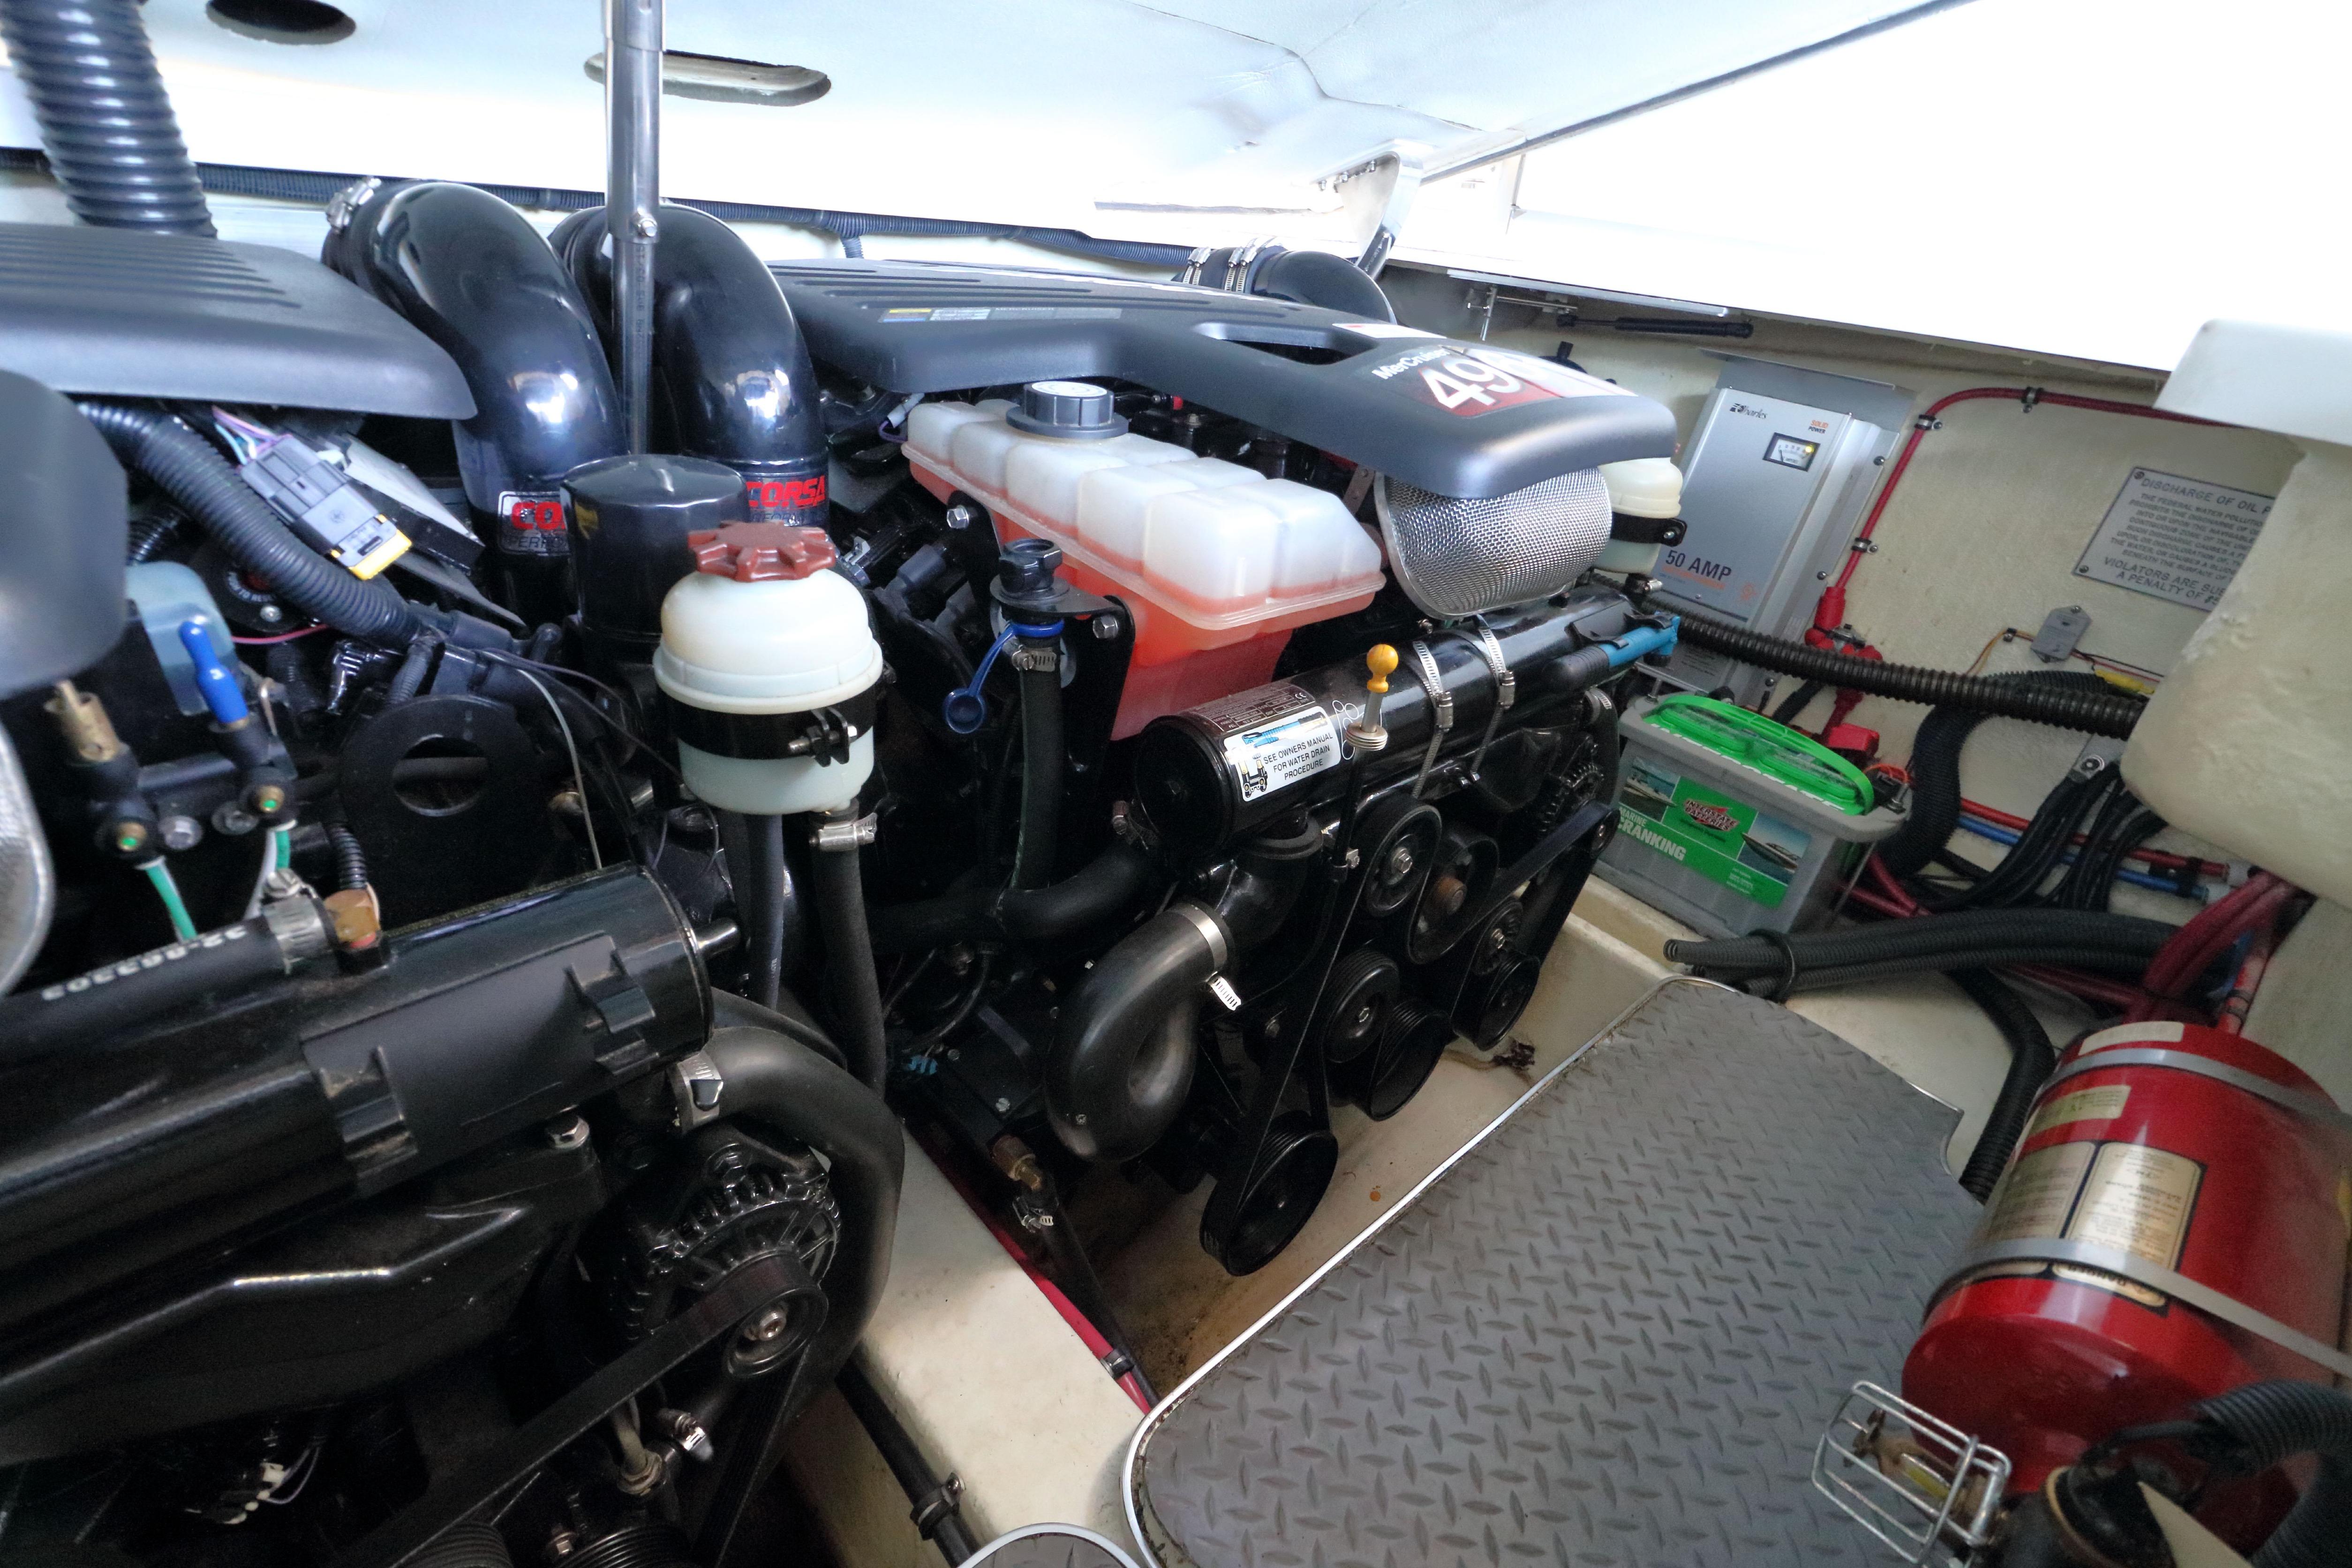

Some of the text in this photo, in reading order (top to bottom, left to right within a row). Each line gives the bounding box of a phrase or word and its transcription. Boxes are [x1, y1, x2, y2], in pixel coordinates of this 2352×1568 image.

[1372, 348, 1450, 379] MerCruiser
[1810, 420, 1829, 429] SOLID
[746, 475, 825, 508] CORSA
[2140, 478, 2214, 502] DISCHARGE
[2215, 495, 2235, 506] OF
[2236, 499, 2262, 513] OIL
[511, 501, 566, 530] CO
[2194, 506, 2224, 517] WATER
[1666, 550, 1686, 567] 50
[1688, 557, 1732, 581] AMP
[2102, 557, 2171, 581] VIOLATORS
[2171, 575, 2199, 588] ARE
[2116, 570, 2126, 580] A
[2127, 573, 2184, 595] PENALTY
[2185, 588, 2203, 600] OF
[1263, 732, 1333, 764] SEE OWNERS MANUAL
[1273, 745, 1330, 773] FOR WATER DRAIN
[1284, 759, 1323, 780] PROCEDURE
[1685, 807, 1730, 831] BATTERIES
[1686, 799, 1736, 826] INTERSTATE
